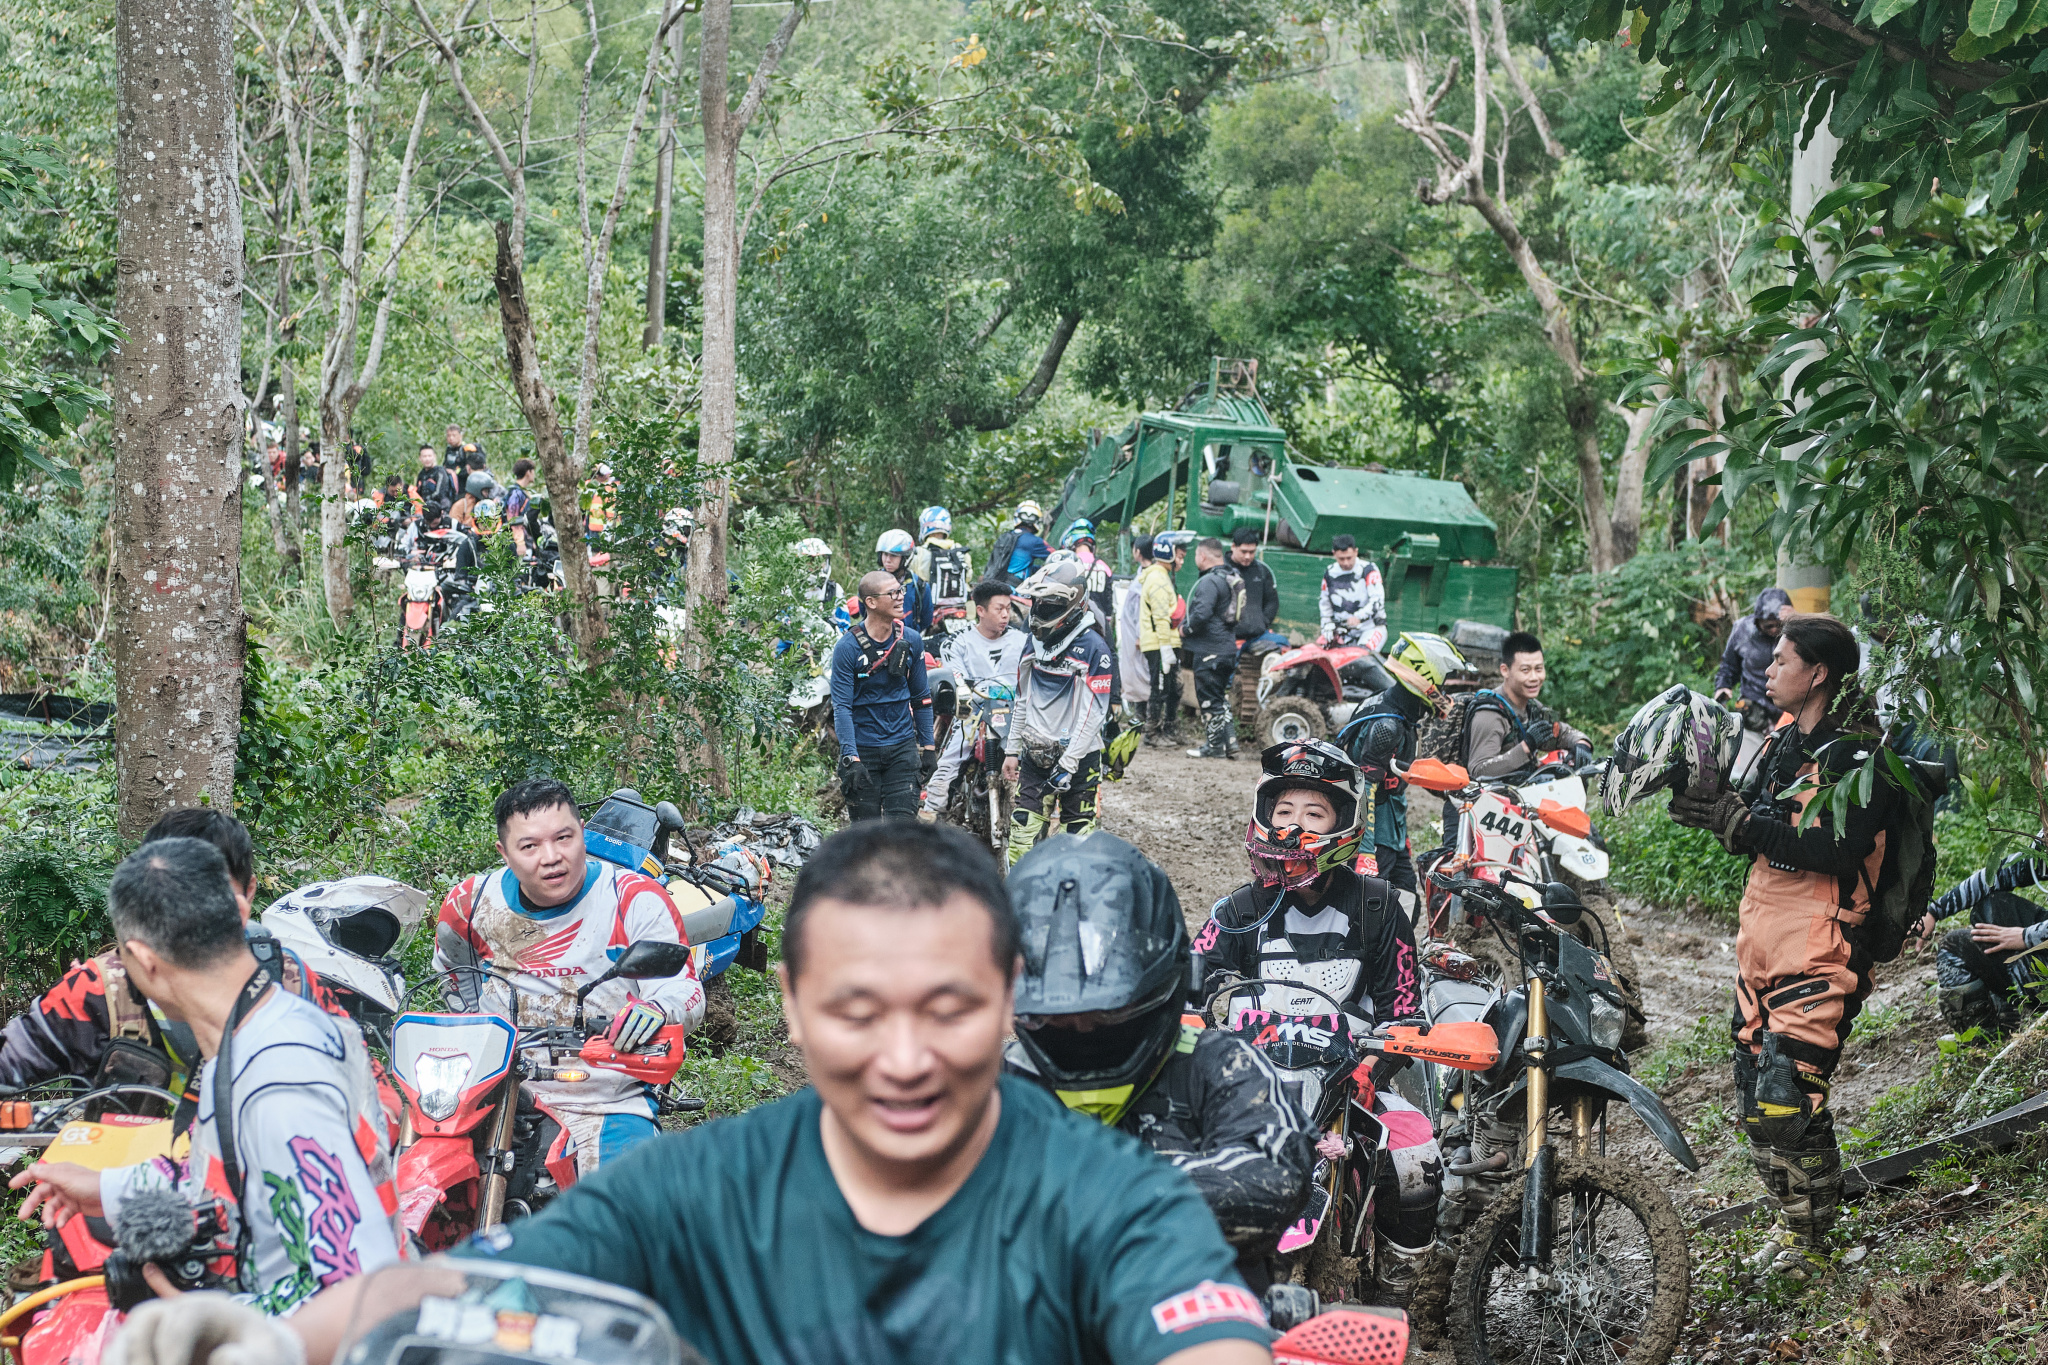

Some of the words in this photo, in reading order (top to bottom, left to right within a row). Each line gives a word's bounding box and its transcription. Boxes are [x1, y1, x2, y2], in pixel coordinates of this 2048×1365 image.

[1285, 761, 1319, 774] Airoh
[1479, 811, 1524, 842] 444
[1290, 997, 1315, 1006] LEATT
[1292, 1041, 1324, 1052] DETAILING
[1402, 1045, 1471, 1061] Barkbusters
[114, 1113, 164, 1125] GASGA
